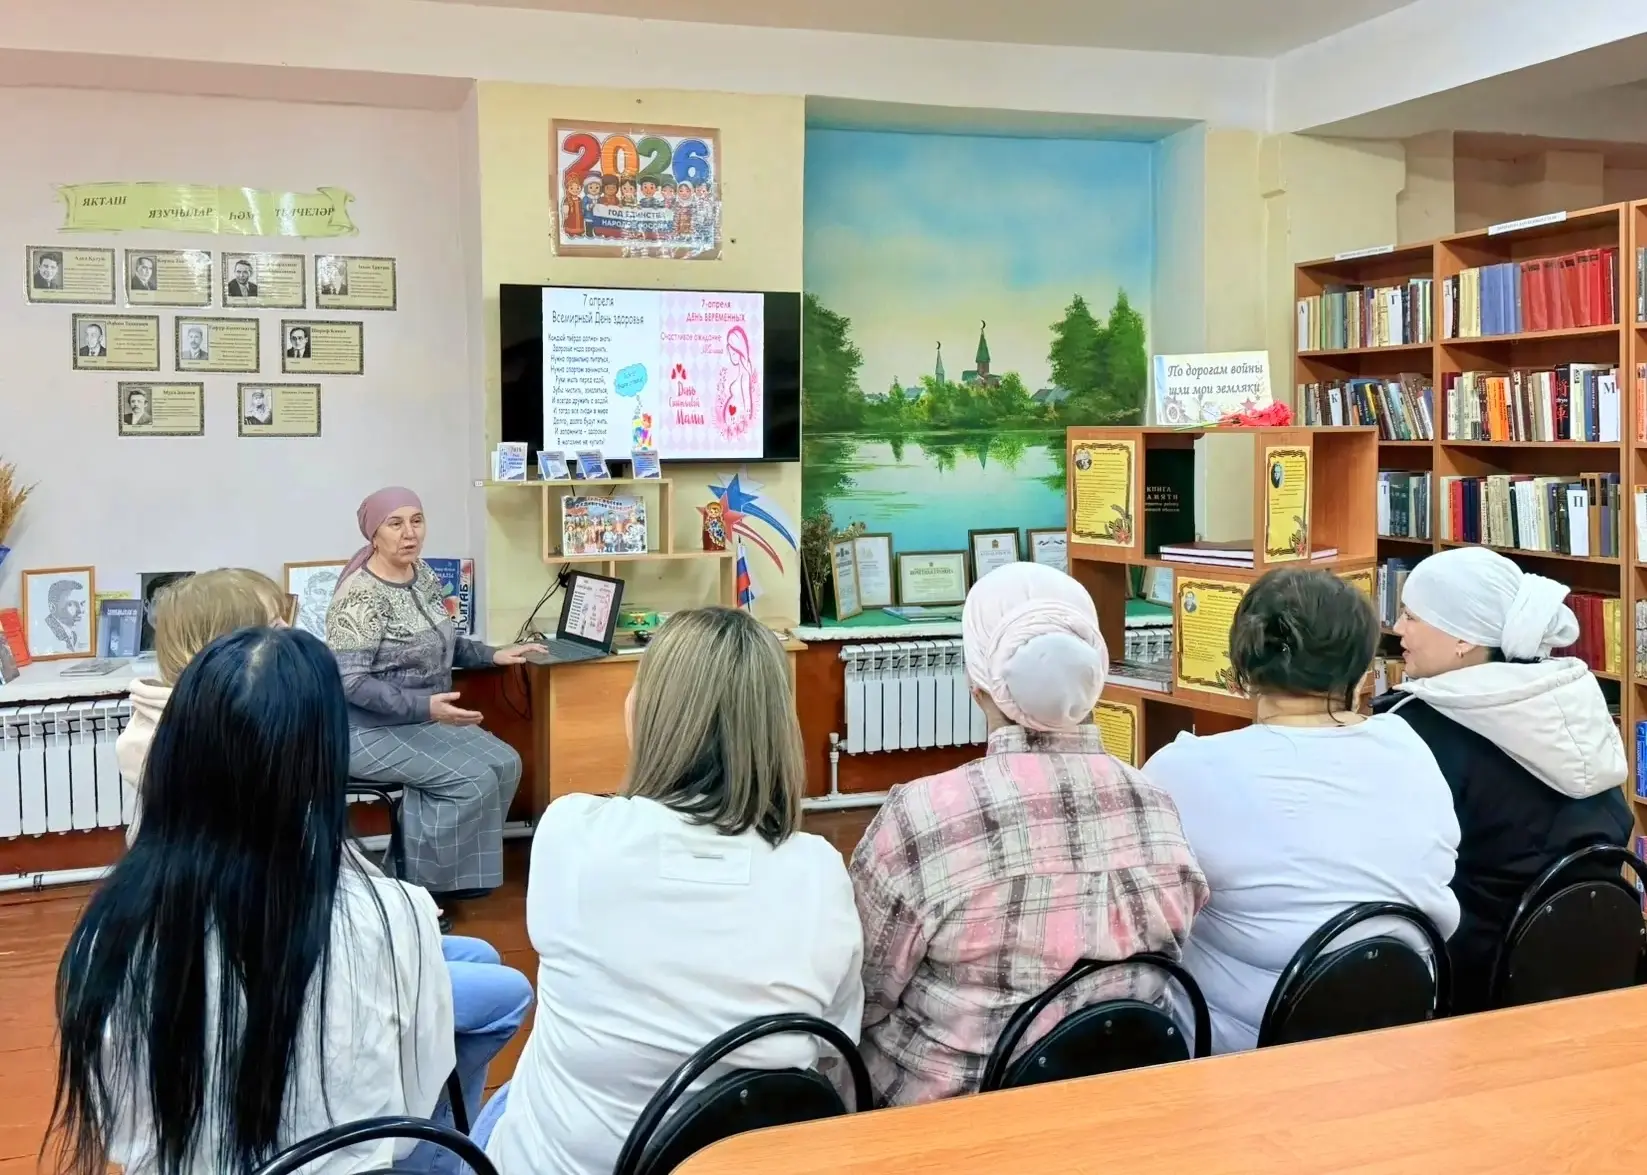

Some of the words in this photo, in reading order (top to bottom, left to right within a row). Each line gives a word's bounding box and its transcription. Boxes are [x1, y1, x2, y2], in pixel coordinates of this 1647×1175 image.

[562, 133, 711, 185] 2026
[82, 196, 127, 206] ЯКТАШ
[148, 208, 212, 218] ЯЗУЧЫЛАР
[608, 209, 623, 218] ГОД
[583, 294, 587, 306] 7
[589, 297, 614, 310] апреля
[1391, 295, 1397, 305] Г
[1299, 305, 1305, 314] А
[552, 311, 593, 327] Всемирный
[595, 312, 611, 325] День
[613, 315, 644, 327] здоровья
[686, 312, 703, 322] ДЕНЬ
[704, 313, 746, 322] БЕРЕМЕННЫХ
[660, 332, 693, 341] Счастливое
[1168, 365, 1183, 377] По
[1186, 363, 1228, 380] дорогам
[1230, 363, 1263, 374] войны
[678, 381, 696, 396] День
[1169, 386, 1189, 396] шли
[1216, 383, 1260, 395] земляки
[1604, 382, 1615, 394] М
[1331, 393, 1338, 403] К
[676, 409, 705, 425] Мамы
[1573, 496, 1584, 507] П
